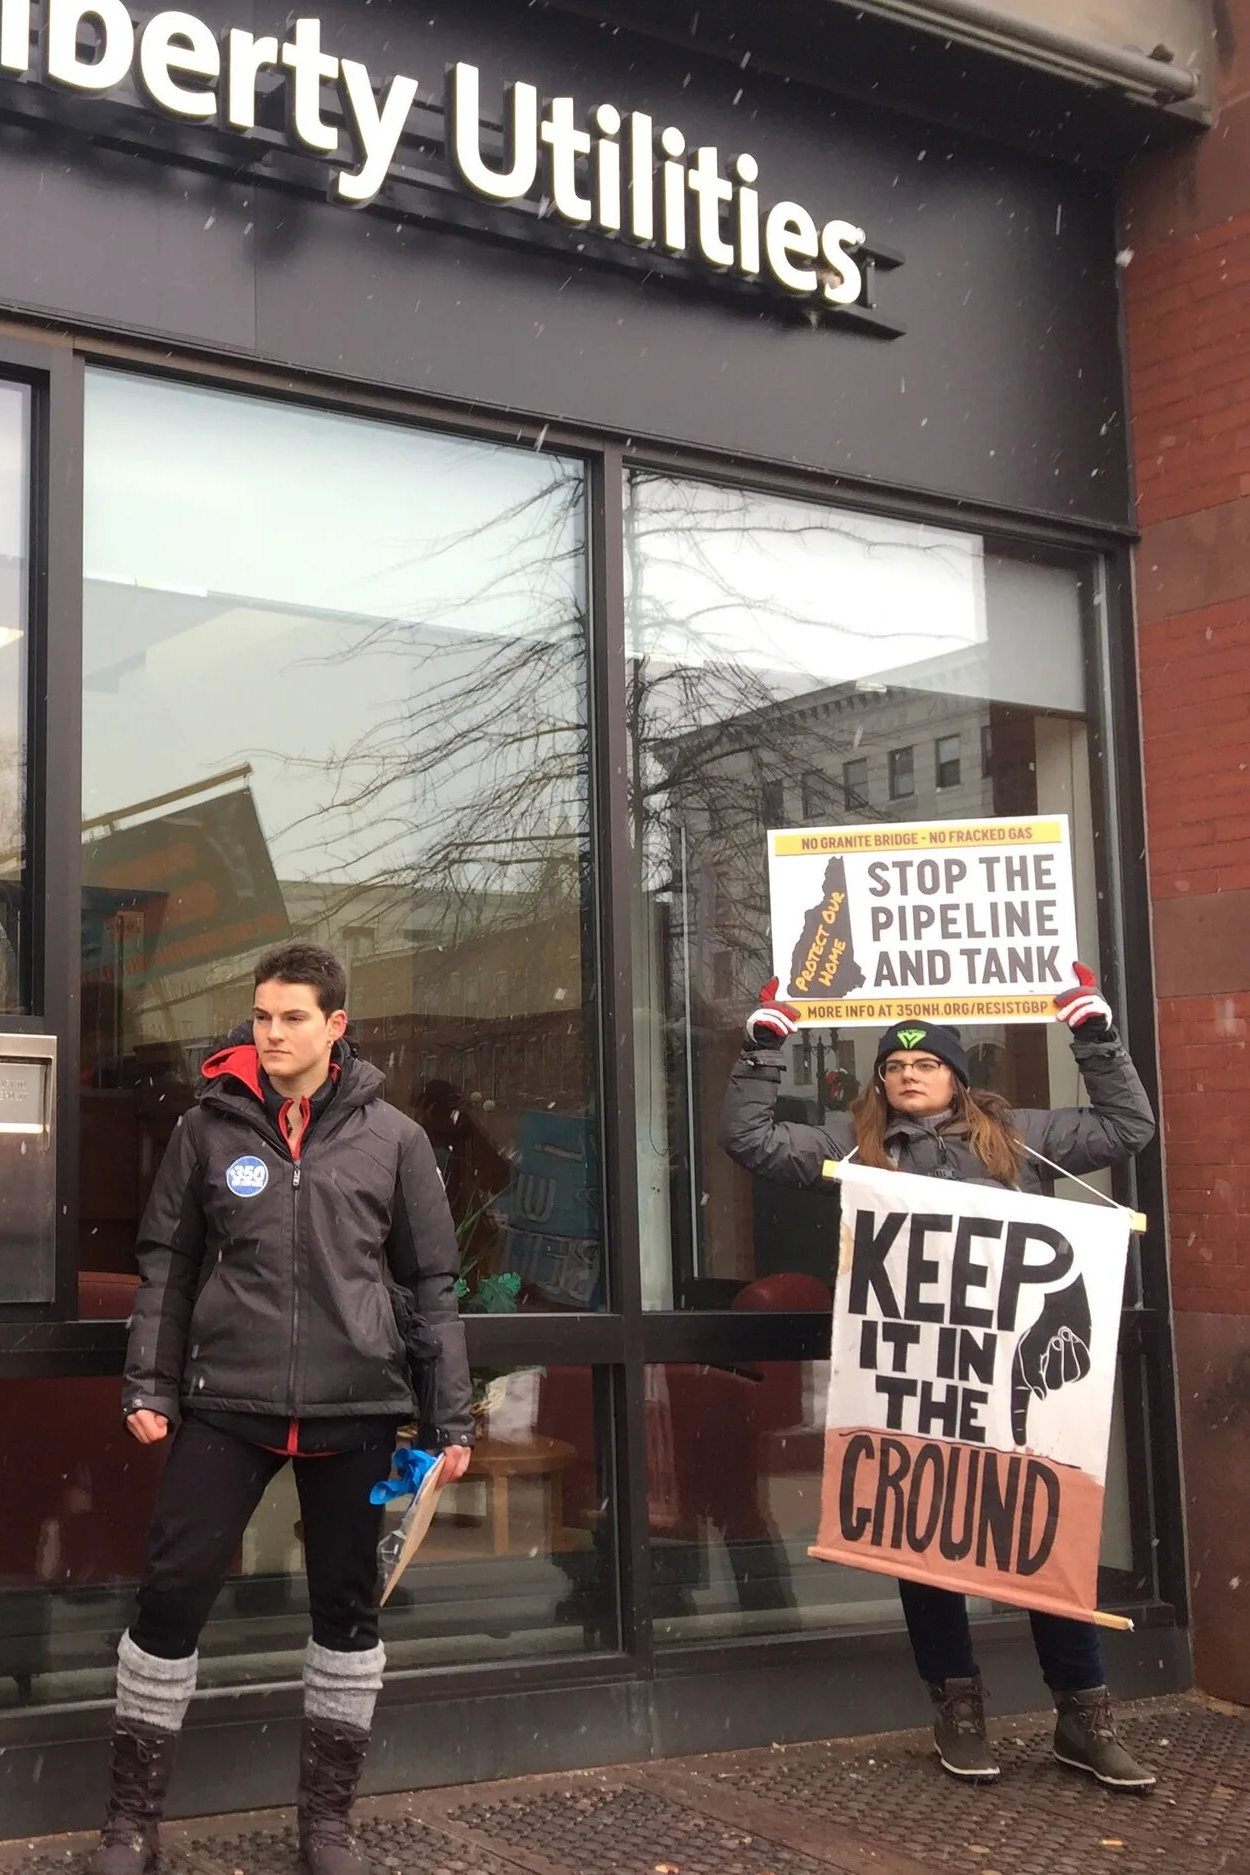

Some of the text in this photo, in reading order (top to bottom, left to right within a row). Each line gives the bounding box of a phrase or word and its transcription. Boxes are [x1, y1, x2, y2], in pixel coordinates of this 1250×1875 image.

[456, 61, 862, 304] Utilities
[801, 837, 818, 850] NO
[820, 835, 872, 849] GRANITE
[874, 832, 919, 847] BRIDGE
[929, 831, 946, 844] NO
[949, 828, 1005, 843] FRACKED
[1008, 827, 1033, 840] GAS
[867, 854, 1057, 897] STOP THE
[795, 892, 845, 992] PROTECT OUR
[870, 900, 1059, 942] PIPELINE
[818, 938, 846, 987] HOME
[874, 945, 1063, 987] AND TANK
[807, 1000, 1048, 1019] MORE INFO AT 350NH.ORG/RESISTGBP
[234, 1165, 265, 1181] 350
[848, 1209, 1074, 1332] KEEP
[859, 1320, 997, 1385] IT IN
[875, 1374, 989, 1443] THE
[839, 1433, 1061, 1576] GROUND
